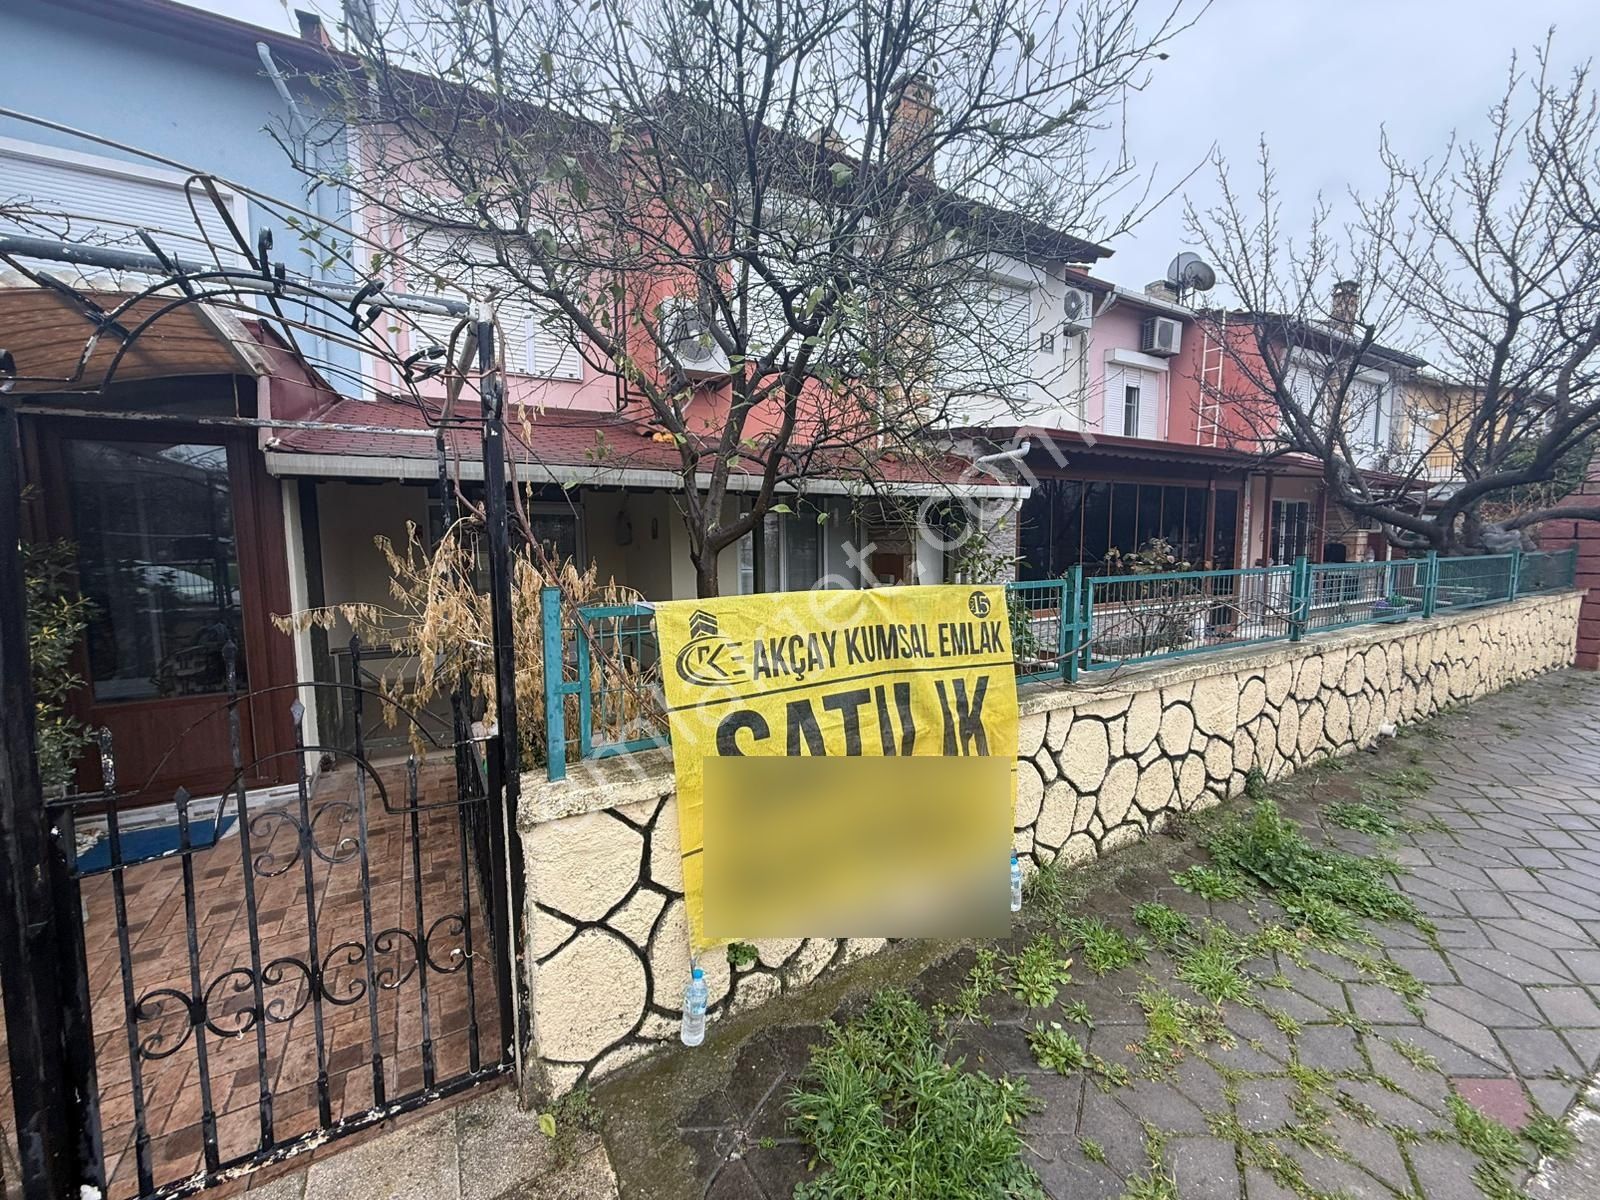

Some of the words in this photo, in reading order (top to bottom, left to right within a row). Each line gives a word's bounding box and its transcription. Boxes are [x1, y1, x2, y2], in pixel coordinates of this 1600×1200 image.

[972, 595, 990, 615] 15
[753, 630, 837, 681] AKÇAY
[844, 623, 935, 665] KUMSAL
[938, 621, 1005, 657] EMLAK
